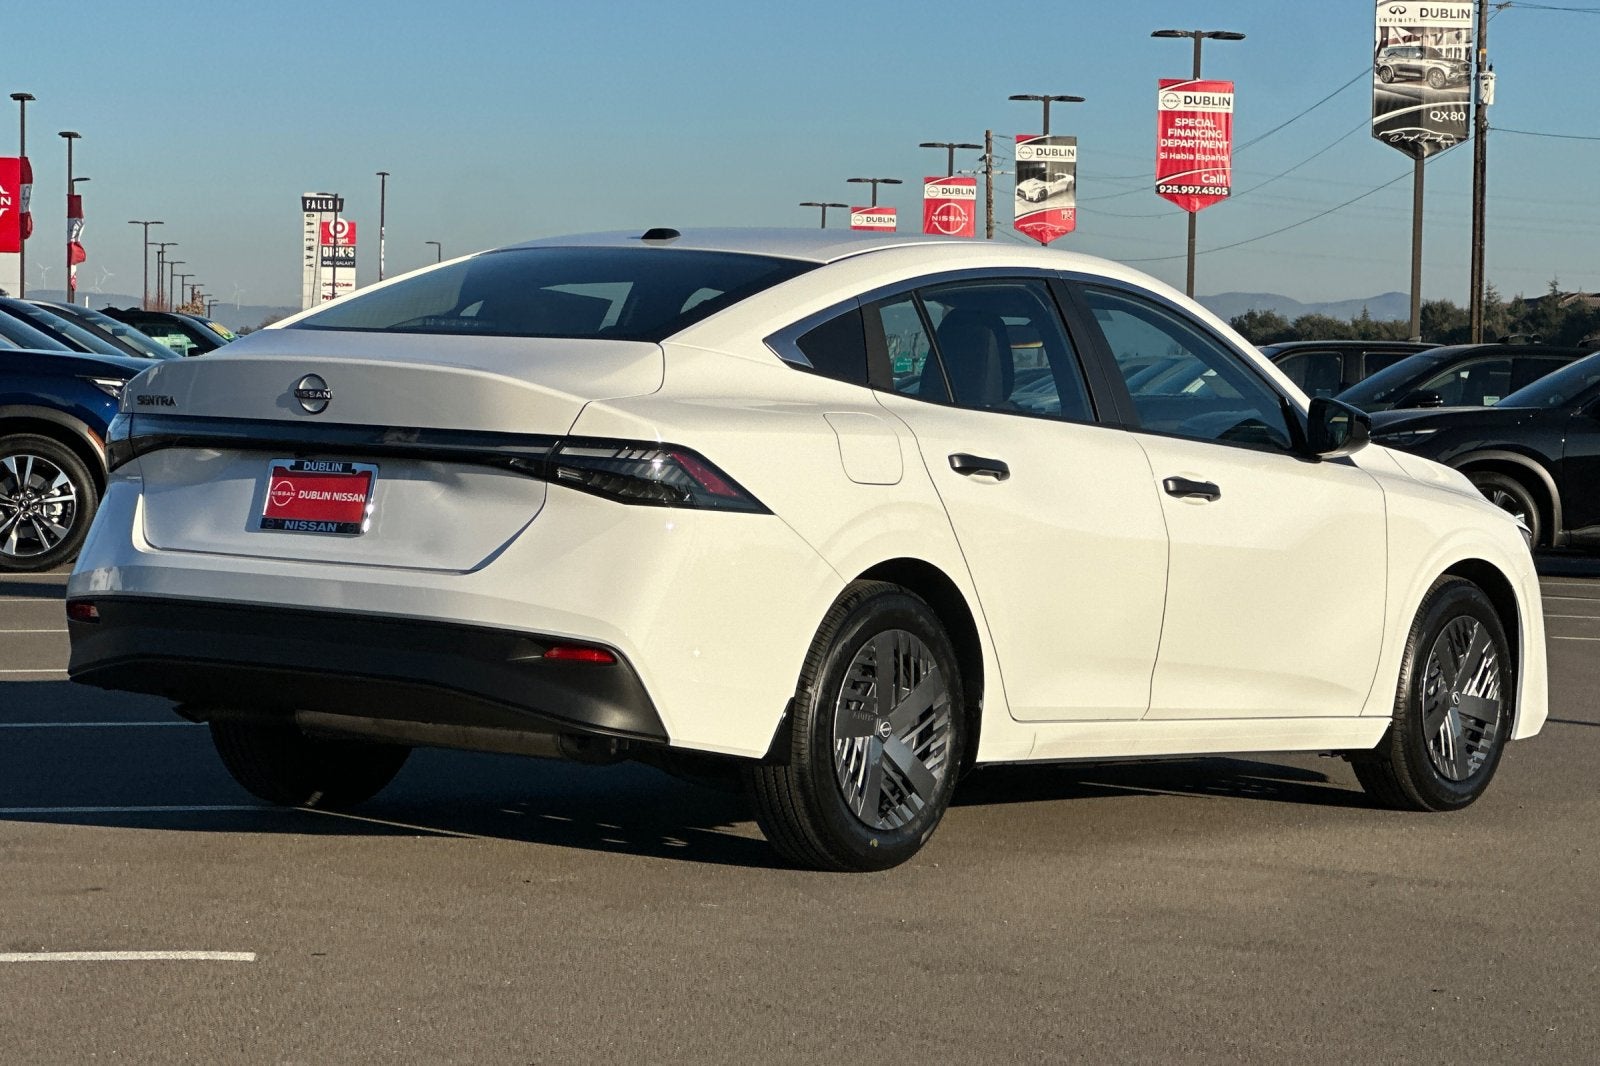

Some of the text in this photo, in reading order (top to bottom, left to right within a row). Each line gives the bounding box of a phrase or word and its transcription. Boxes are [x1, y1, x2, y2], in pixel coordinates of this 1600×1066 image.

[1420, 7, 1471, 19] DUBLIN
[1183, 95, 1231, 106] DUBLIN
[1429, 110, 1466, 122] QX80
[1174, 117, 1217, 128] SPECIAL
[1167, 128, 1223, 139] FINANCING
[1160, 139, 1229, 149] DEPARTMENT
[1036, 147, 1075, 157] DUBLIN
[1159, 152, 1168, 160] Si
[1169, 152, 1195, 160] Habla
[1201, 173, 1227, 184] Call!
[941, 187, 975, 195] DUBLIN
[1159, 185, 1229, 195] 925.997.4505
[931, 214, 969, 223] NISSAN
[305, 213, 315, 268] GATEWAY
[295, 389, 331, 399] NISSAN
[136, 394, 176, 406] SENTRA
[303, 461, 343, 472] DUBLIN
[298, 490, 332, 501] DUBLIN
[332, 492, 366, 503] NISSAN
[284, 520, 338, 532] NISSAN
